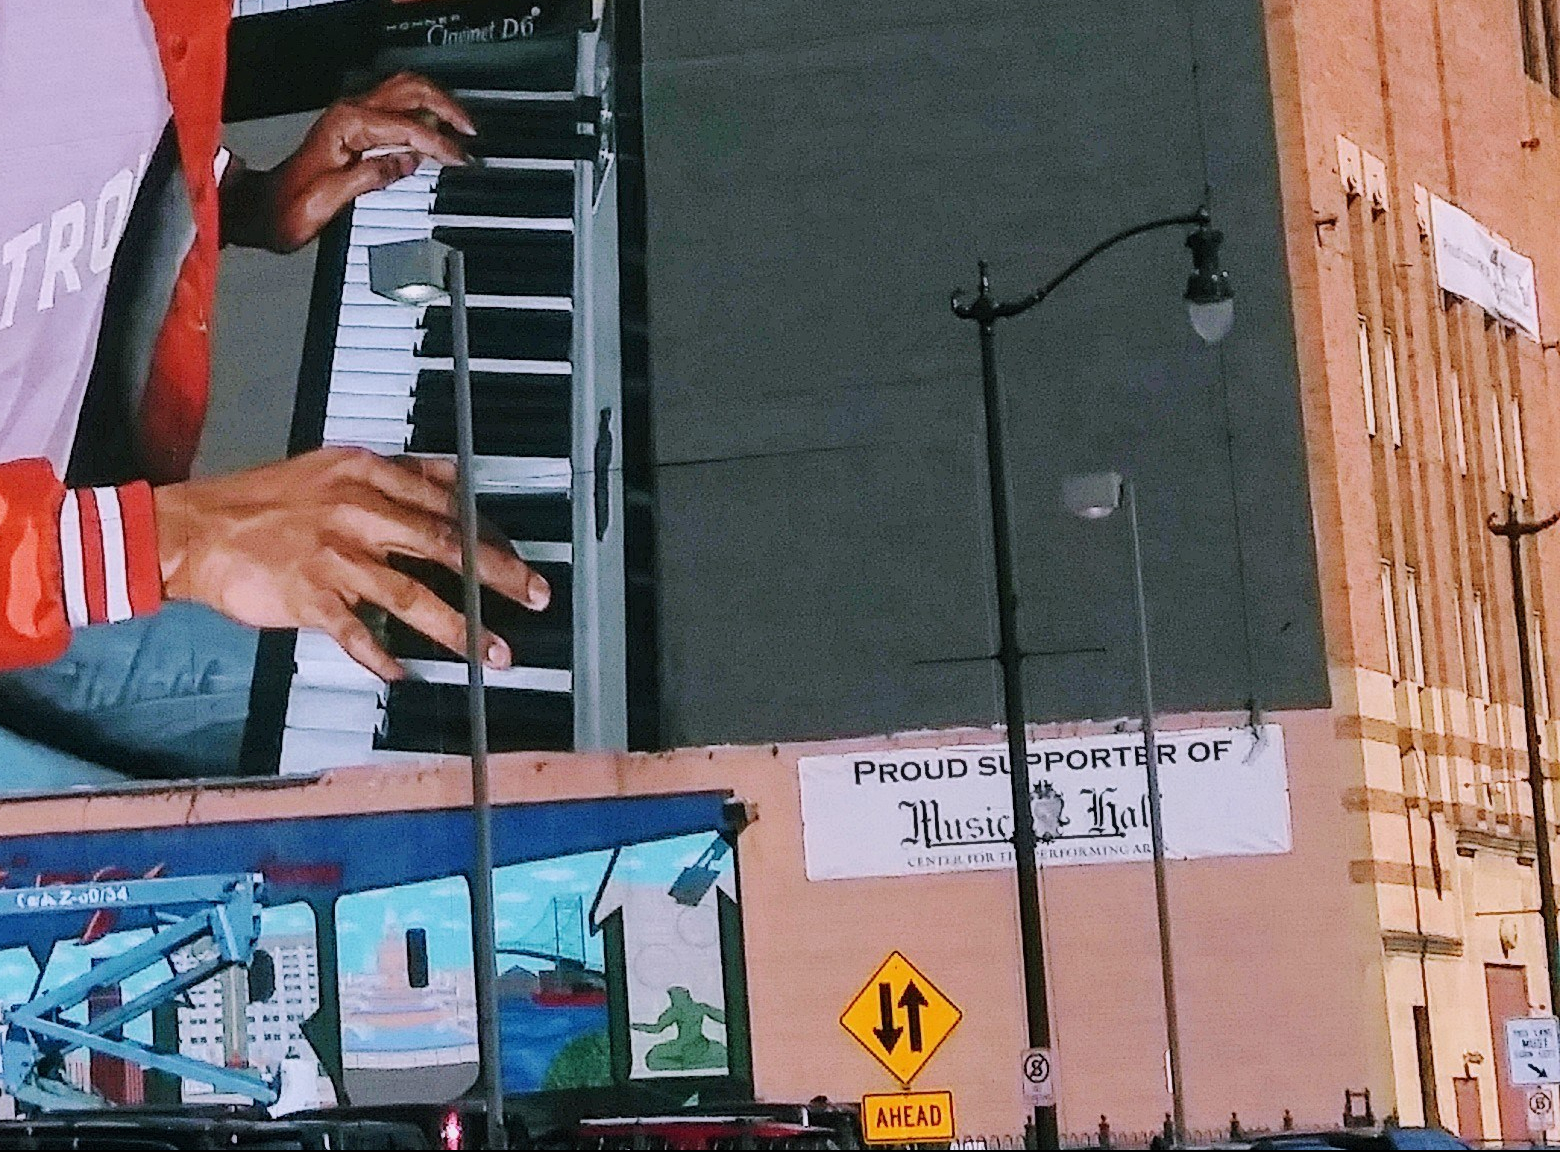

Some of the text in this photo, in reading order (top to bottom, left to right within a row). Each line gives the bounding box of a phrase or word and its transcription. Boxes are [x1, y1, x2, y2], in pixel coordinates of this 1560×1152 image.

[854, 757, 968, 786] PROUD
[1187, 739, 1233, 764] OF
[898, 799, 1010, 849] Music
[967, 851, 995, 865] FOR
[876, 1104, 942, 1129] AHEAD
